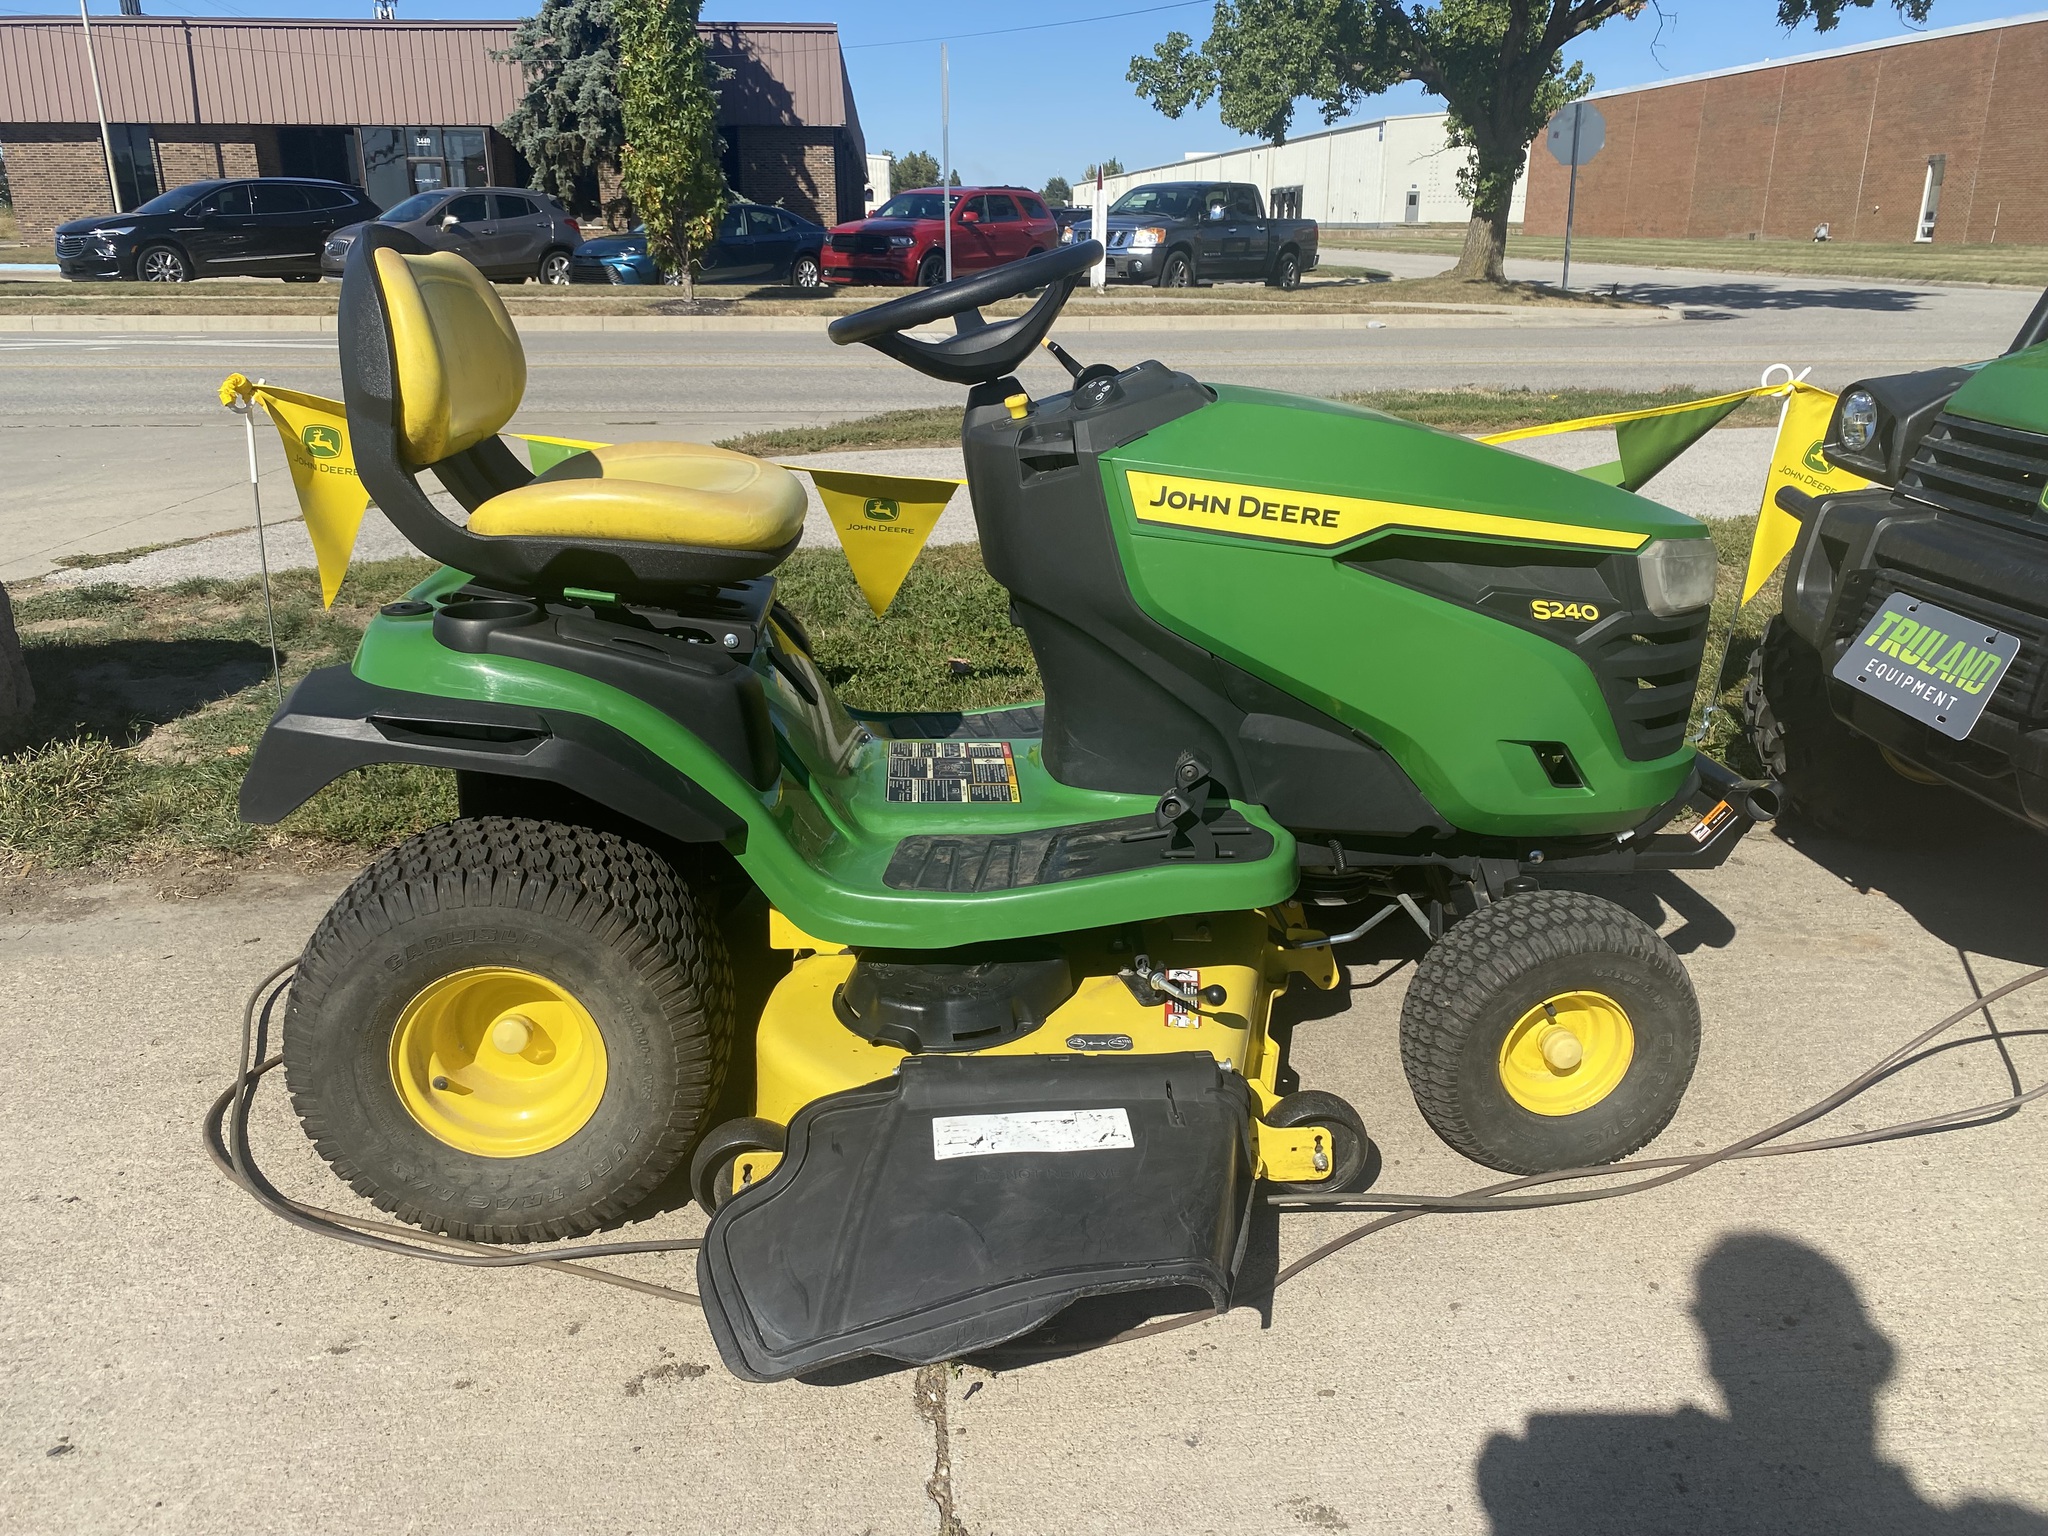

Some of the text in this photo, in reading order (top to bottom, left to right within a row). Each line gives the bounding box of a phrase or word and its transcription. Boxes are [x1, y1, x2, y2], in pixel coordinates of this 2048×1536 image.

[294, 454, 317, 471] JOHN
[1779, 465, 1804, 480] JOHN
[1150, 486, 1340, 528] JOHN DEERE
[846, 524, 915, 534] JOHN DEERE
[1530, 600, 1600, 621] S240
[1864, 610, 2002, 695] TRULAND
[1864, 658, 1958, 711] EQUIPMENT
[384, 927, 542, 972] CARLISLE
[578, 1125, 641, 1191] TURF
[1006, 1168, 1042, 1180] NOT
[1047, 1167, 1121, 1181] REMOVE
[466, 1186, 565, 1211] TRAC
